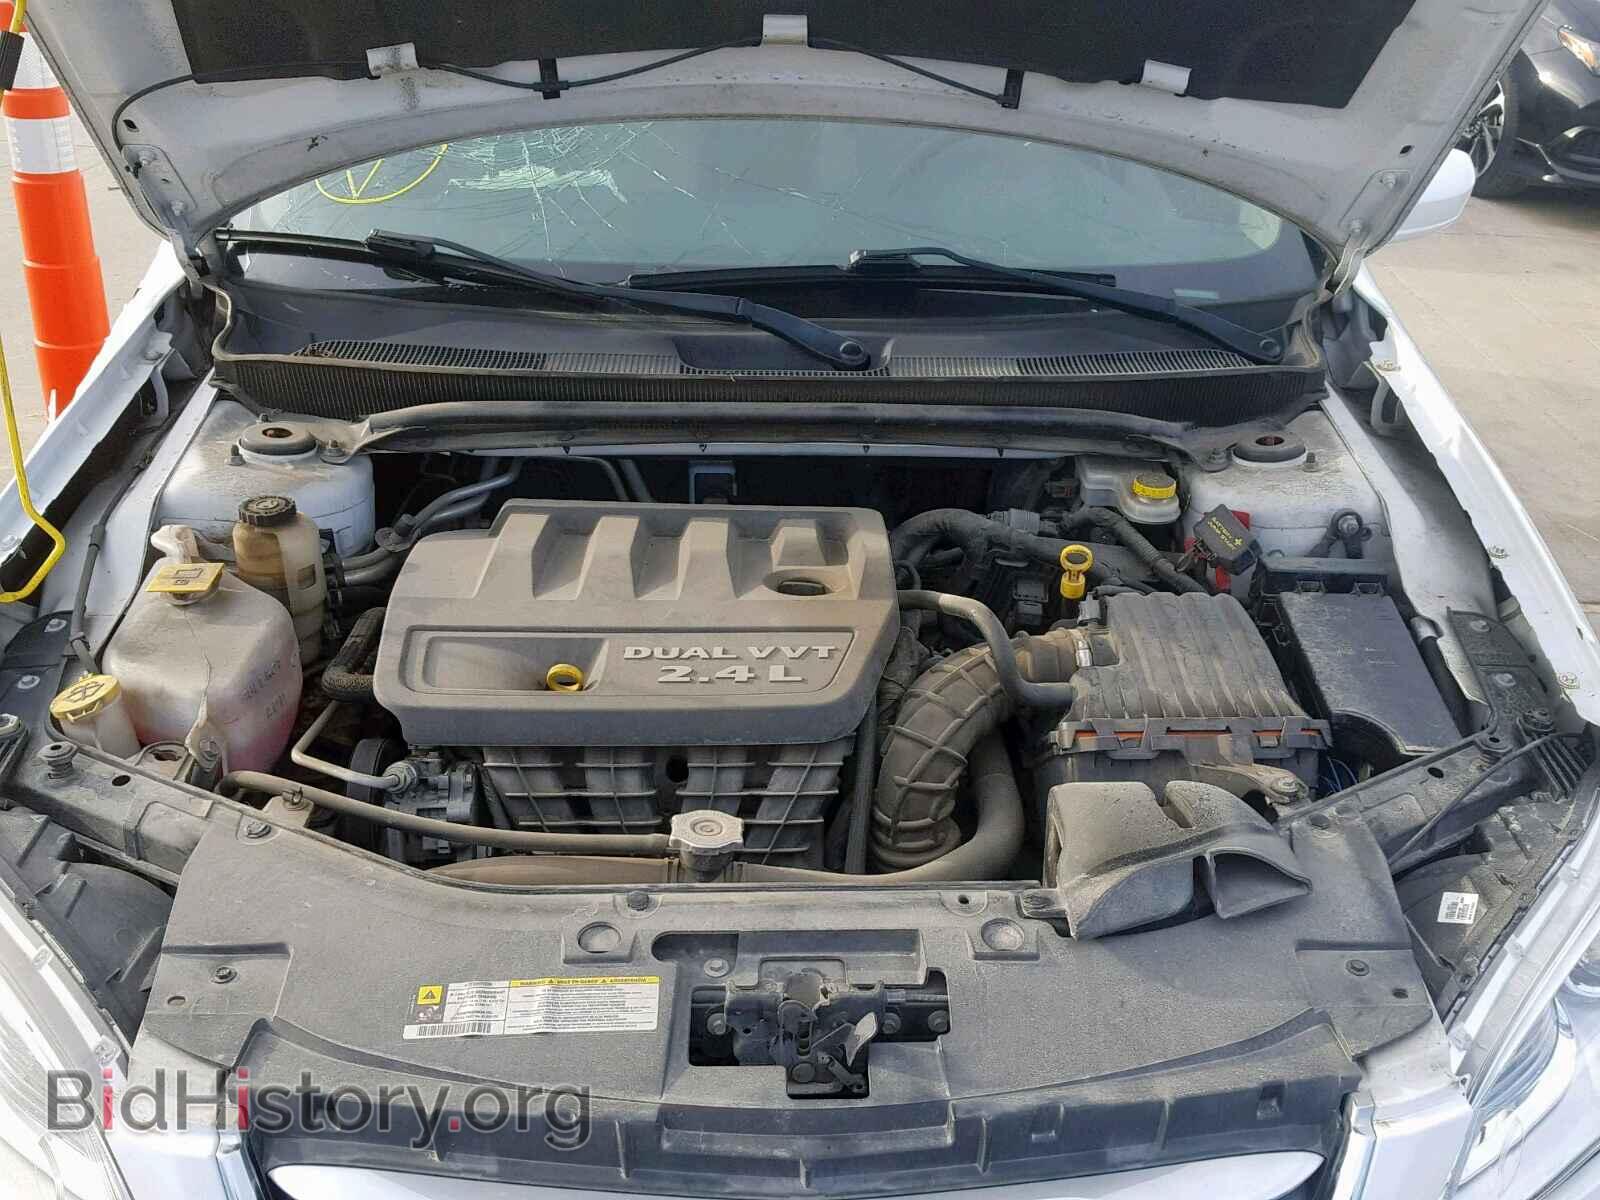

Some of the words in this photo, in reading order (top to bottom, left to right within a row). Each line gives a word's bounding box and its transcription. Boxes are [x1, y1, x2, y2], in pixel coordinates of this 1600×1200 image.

[624, 645, 738, 660] DUAL
[748, 645, 837, 660] VVT
[658, 664, 756, 684] 2.4
[769, 664, 806, 683] L
